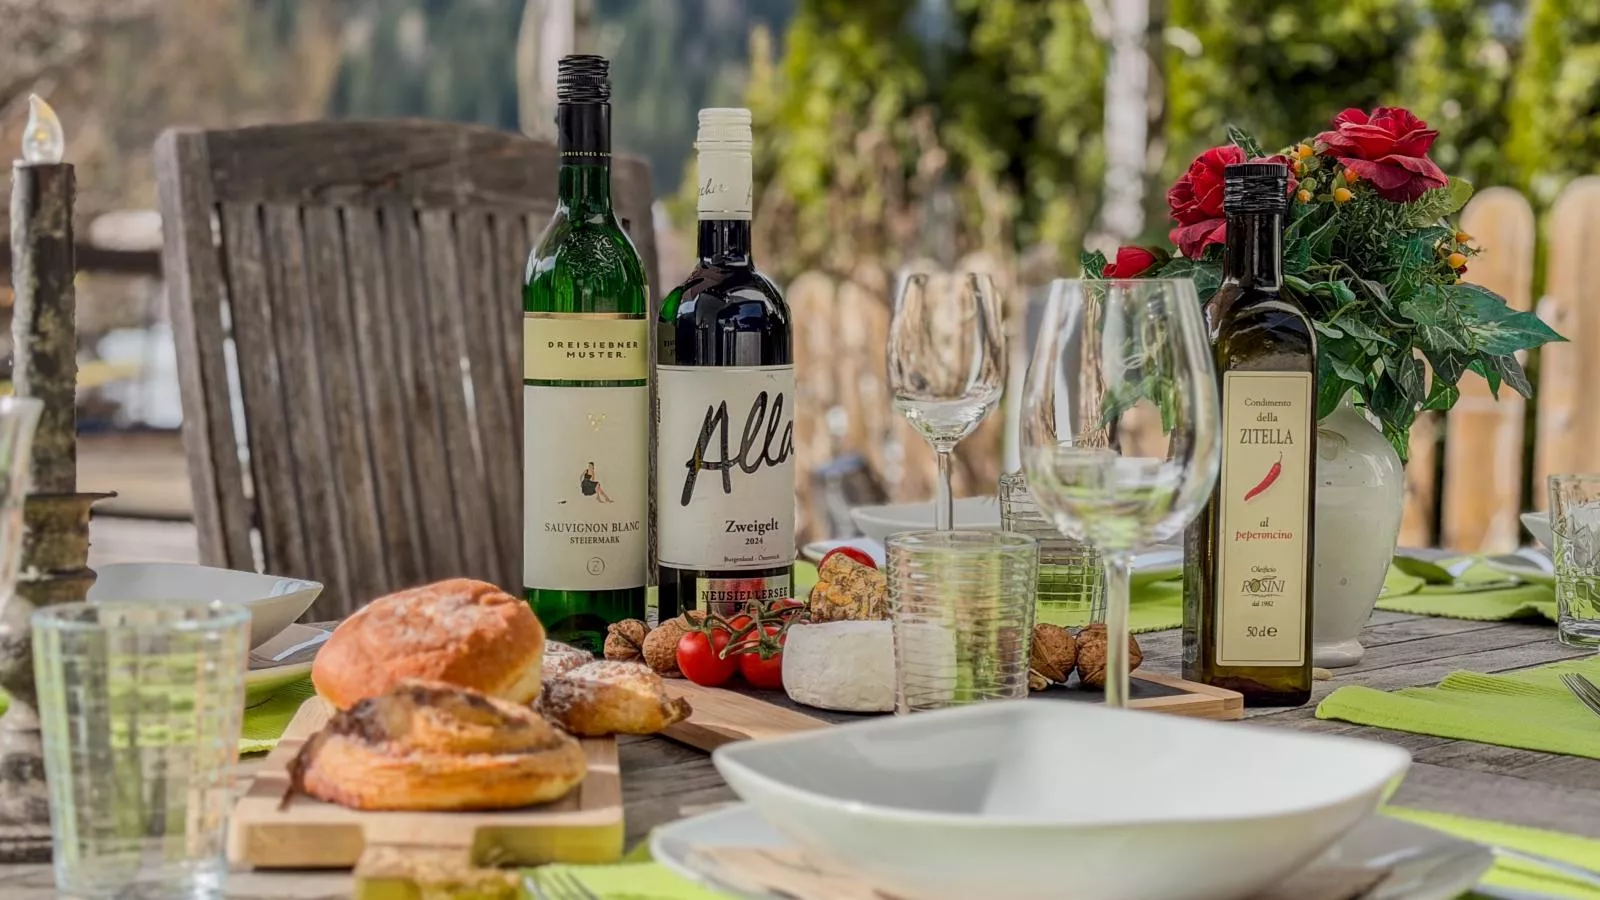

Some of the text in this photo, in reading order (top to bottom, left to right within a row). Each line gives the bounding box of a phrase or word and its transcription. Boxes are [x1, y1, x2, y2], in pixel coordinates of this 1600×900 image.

[547, 341, 640, 349] DREISIEBNER
[566, 351, 627, 359] MUSTER.
[1244, 397, 1292, 407] Condimento
[1256, 412, 1278, 422] della
[1240, 428, 1294, 445] ZITELLA
[544, 520, 640, 533] SAUVIGNON BLANC
[725, 517, 779, 535] Zweigelt
[1259, 516, 1270, 528] al
[569, 536, 620, 545] STEIERMARK
[745, 537, 764, 545] 2024
[1235, 530, 1293, 541] peperoncino
[1240, 579, 1286, 594] ROSINI
[1246, 626, 1258, 638] 50
